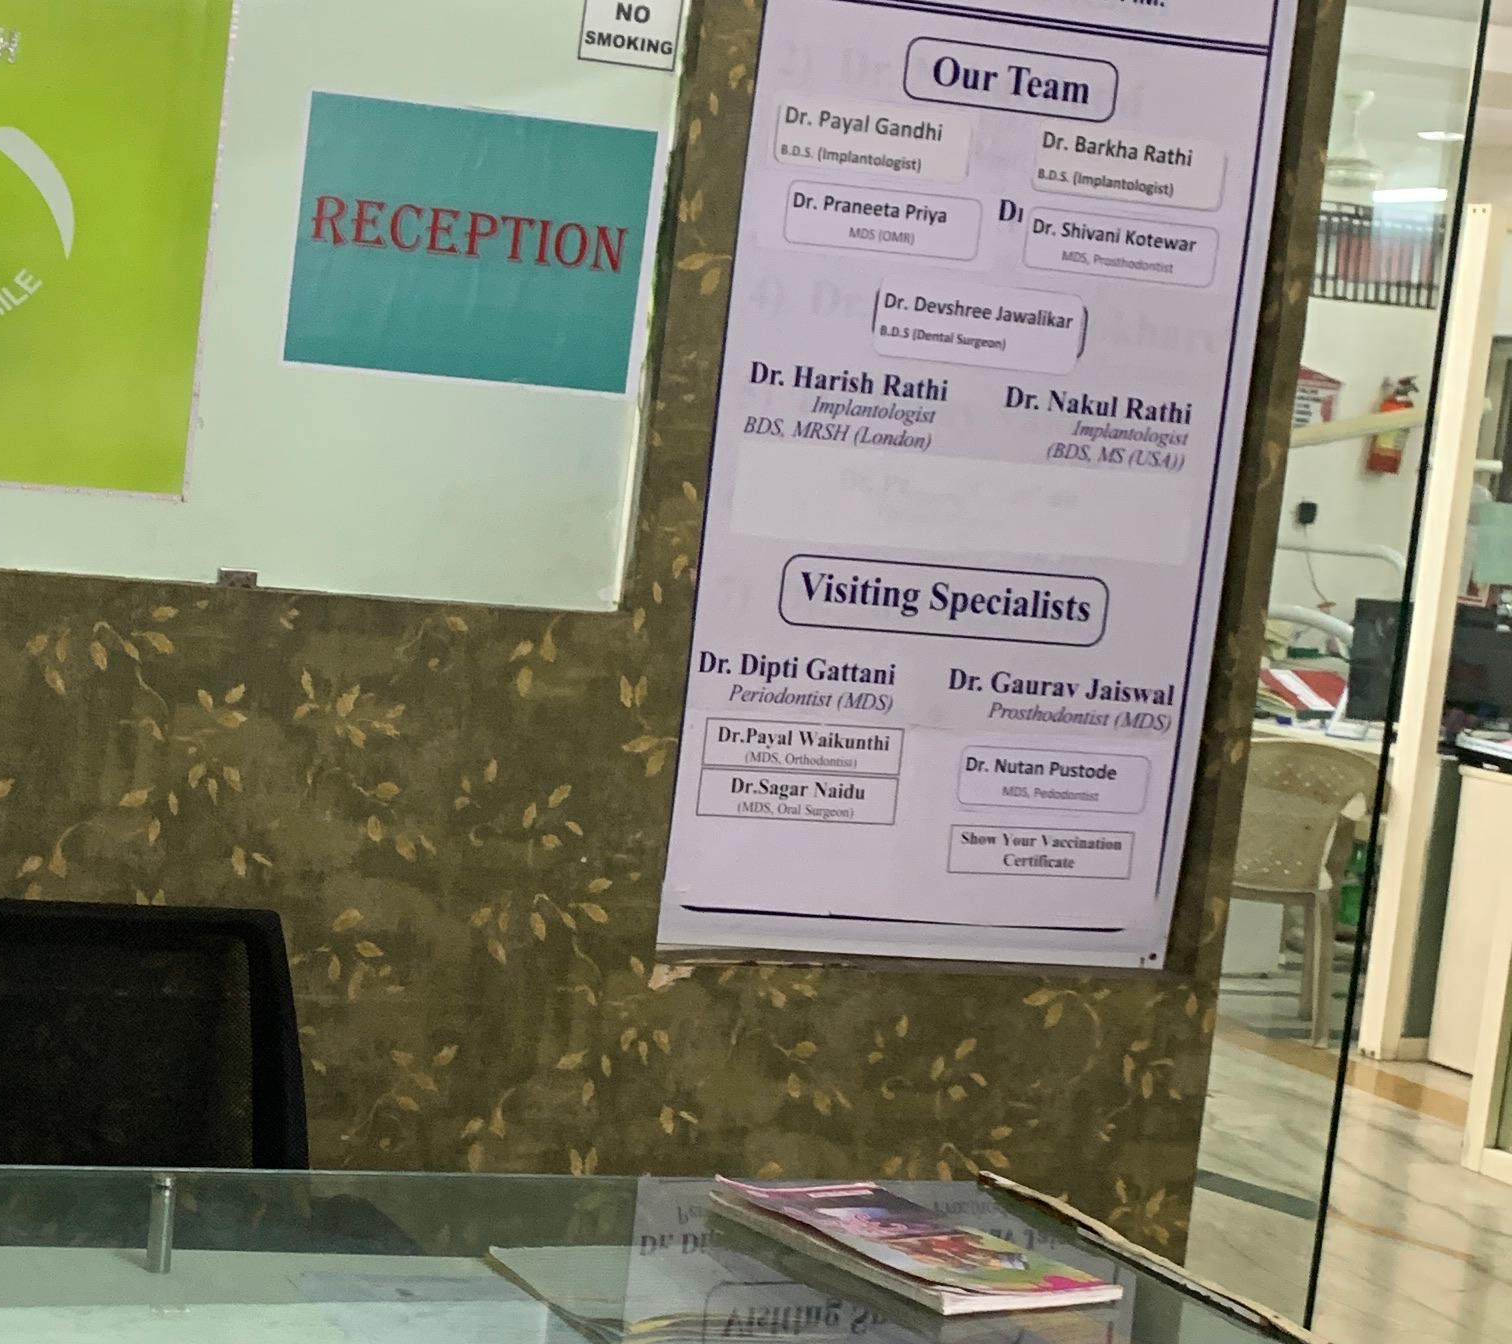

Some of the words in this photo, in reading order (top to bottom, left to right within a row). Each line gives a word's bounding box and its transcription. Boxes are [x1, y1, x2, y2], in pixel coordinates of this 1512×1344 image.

[616, 1, 650, 24] NO
[584, 29, 673, 56] SMOKING
[933, 56, 999, 92] Our
[1008, 65, 1090, 104] Team
[785, 106, 812, 126] Dr.
[819, 110, 870, 134] Payal
[875, 118, 943, 141] Gandhi
[780, 144, 814, 159] B.D.S.
[817, 146, 922, 173] (Implantologist)
[1042, 131, 1069, 151] Dr.
[1075, 136, 1138, 160] Barkha
[1143, 145, 1193, 166] Rathi
[1073, 171, 1174, 198] (Implantologist)
[793, 192, 817, 209] Dr.
[823, 196, 900, 218] Praneeta
[905, 204, 947, 225] Priya
[311, 194, 628, 274] RECEPTION
[849, 227, 876, 241] MDS
[878, 229, 915, 246] (OMR)
[1033, 219, 1056, 236] Dr.
[1061, 222, 1120, 244] Shivani
[1125, 230, 1197, 253] Kotewar
[884, 293, 908, 311] Dr.
[914, 296, 993, 320] Devshree
[995, 306, 1074, 330] Jawalikar
[912, 326, 954, 344] (Dental
[957, 333, 1007, 351] Surgeon)
[750, 361, 785, 387] Dr.
[793, 364, 874, 395] Harish
[883, 373, 949, 402] Rathi
[811, 396, 936, 426] Implantologist
[1004, 386, 1039, 410] Dr.
[1047, 390, 1118, 418] Nakul
[1125, 397, 1193, 425] Rathi
[792, 421, 849, 442] MRSH
[853, 426, 933, 452] (London)
[1072, 420, 1189, 448] Implantologist
[1097, 446, 1126, 464] MS
[801, 571, 921, 617] Visiting
[929, 581, 1091, 623] Specialists
[698, 650, 731, 675] Dr.
[741, 653, 798, 683] Dipti
[806, 657, 896, 686] Gattani
[729, 684, 833, 708] Periodontist
[837, 692, 894, 715] (MDS)
[949, 668, 982, 692] Dr.
[991, 671, 1080, 697] Gaurav
[1085, 678, 1175, 706] Jaiswal
[988, 702, 1109, 727] Prosthodontist
[1113, 711, 1172, 733] (MDS)
[717, 726, 792, 749] Dr.Payal
[800, 730, 890, 752] Waikunthi
[966, 756, 989, 773] Dr.
[994, 758, 1044, 775] Nutan
[1049, 761, 1118, 780] Pustode
[731, 777, 808, 800] Dr.Sagar
[814, 781, 866, 800] Naidu
[777, 803, 801, 815] Oral
[961, 832, 996, 846] Show
[1002, 833, 1037, 847] Your
[1041, 834, 1122, 851] Vaccination
[1003, 853, 1075, 869] Certificate
